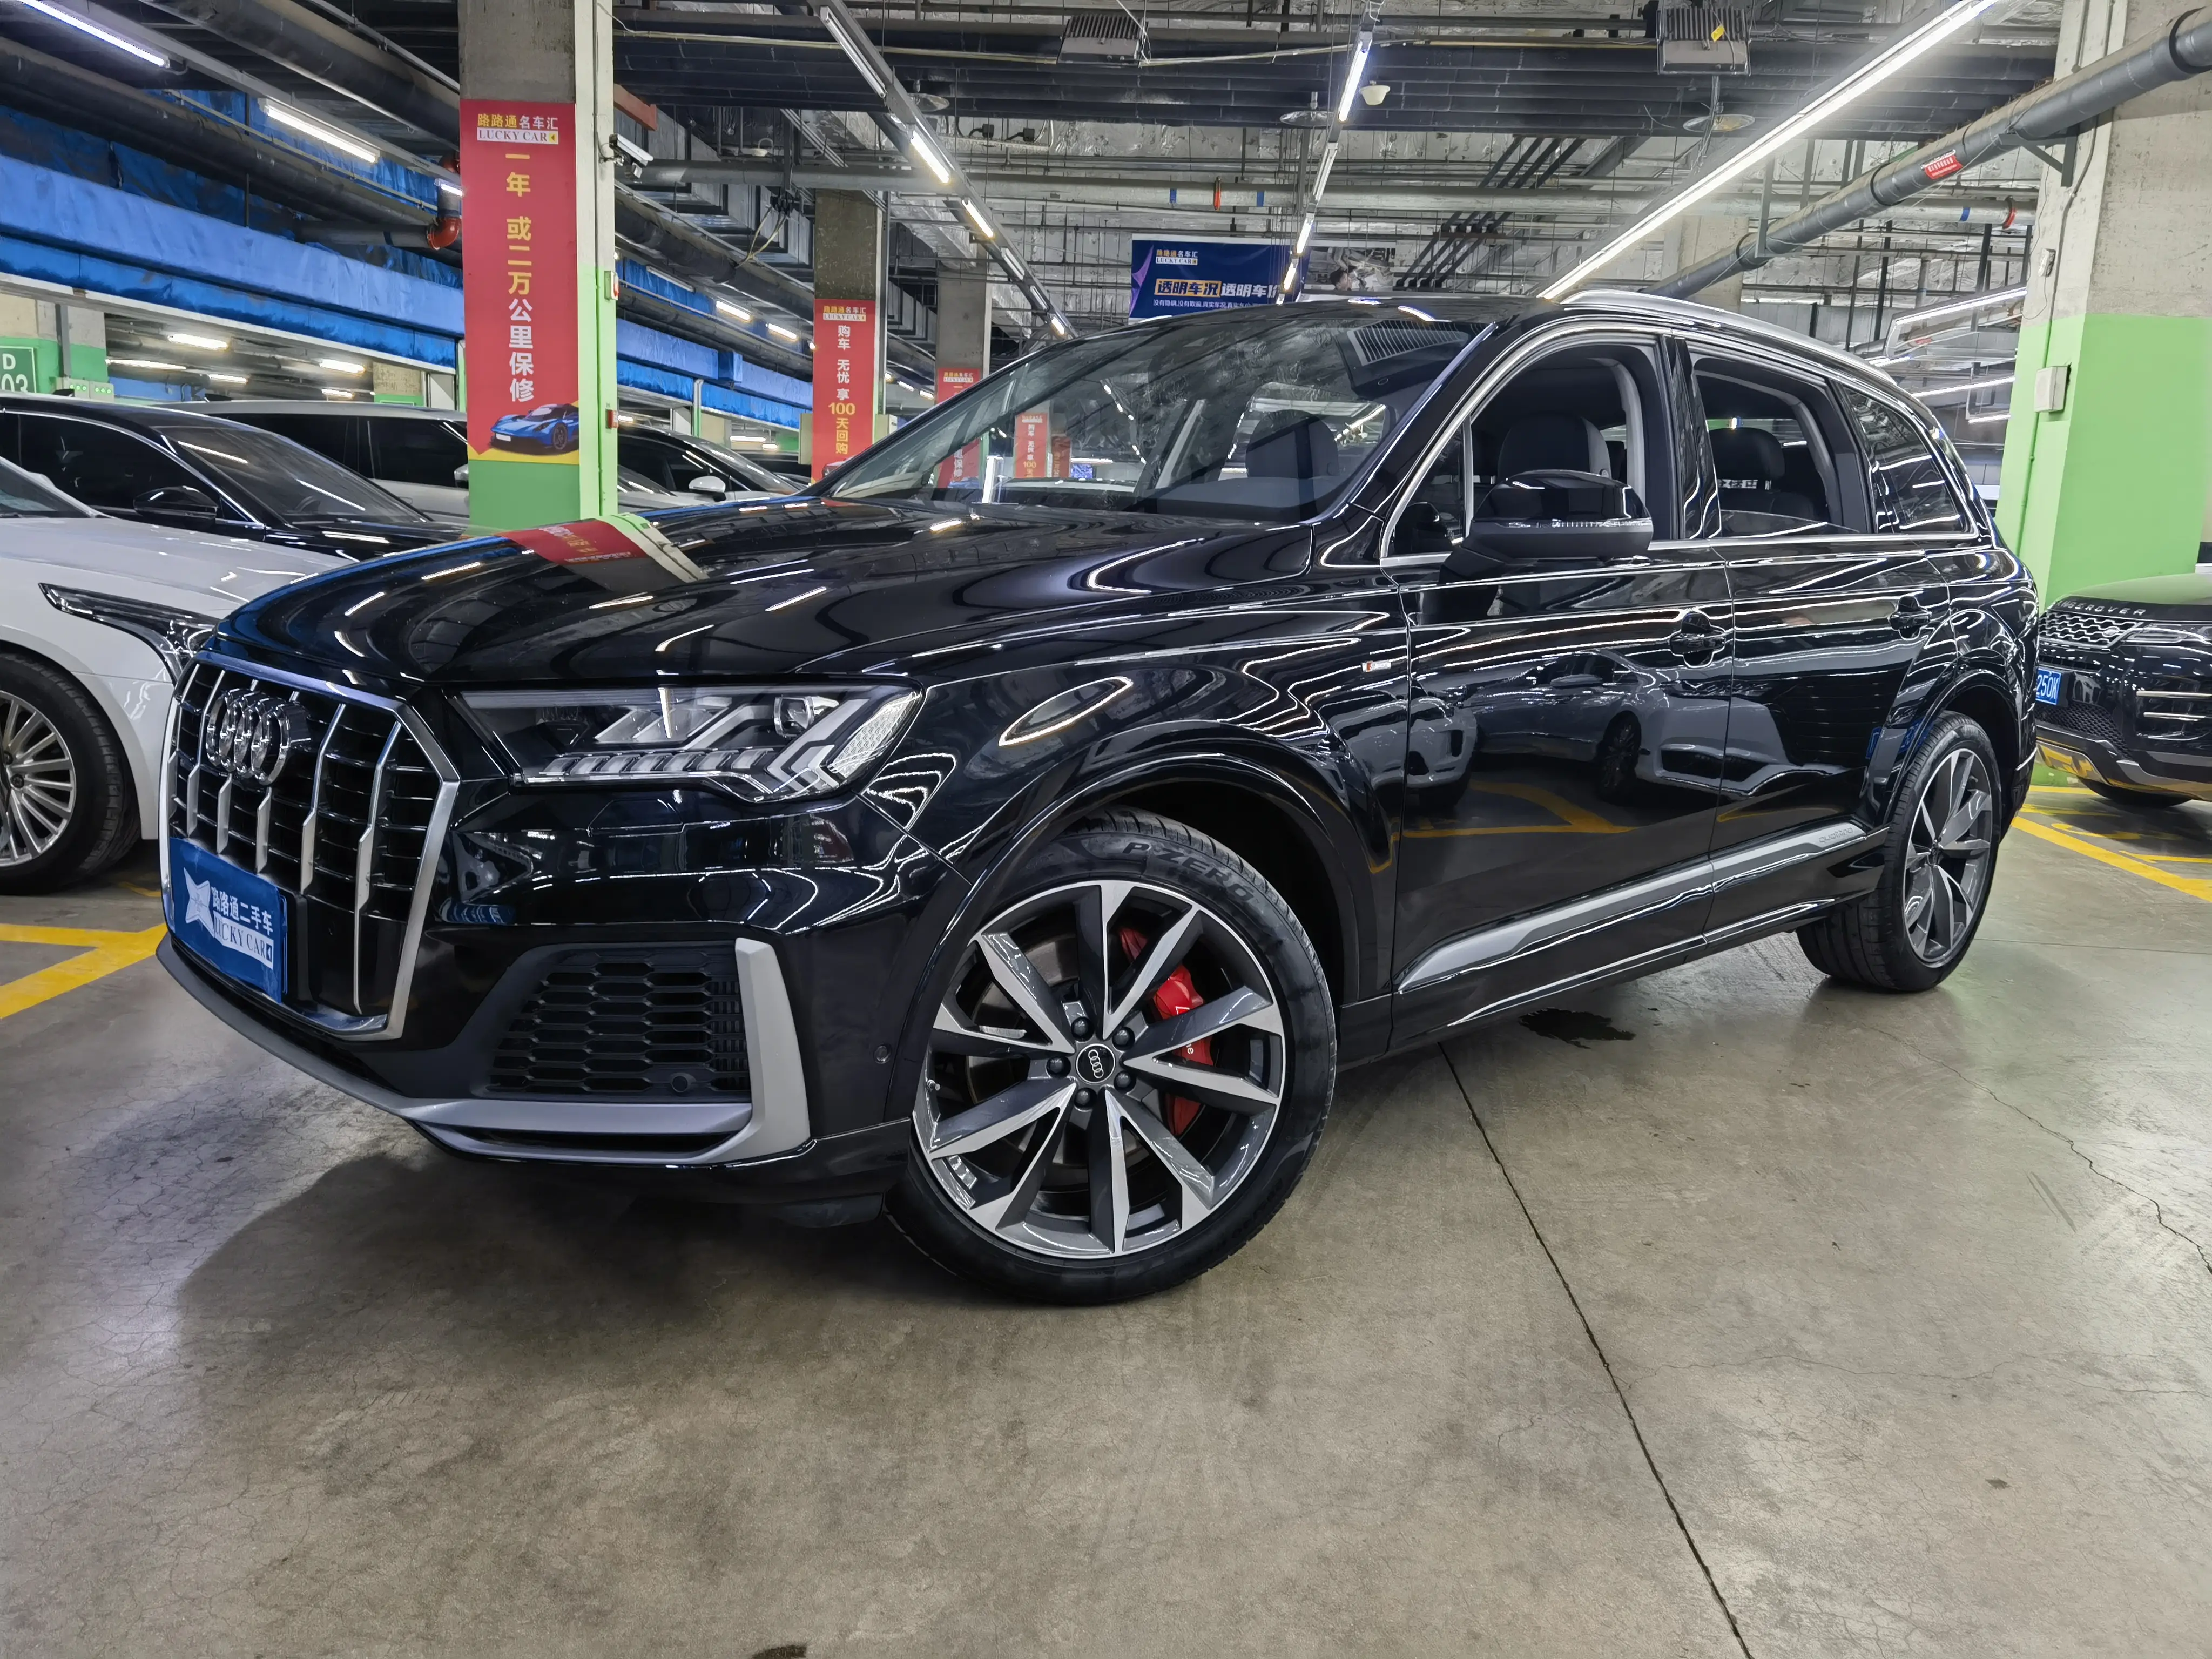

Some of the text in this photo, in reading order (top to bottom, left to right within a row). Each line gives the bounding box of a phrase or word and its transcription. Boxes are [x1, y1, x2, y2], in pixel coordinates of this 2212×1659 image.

[477, 113, 558, 130] 路路通名车汇
[478, 129, 548, 142] LUCKY CAR
[1157, 280, 1218, 296] 透明车况
[2, 353, 16, 370] D
[2085, 604, 2146, 616] ROVER
[1156, 847, 1255, 902] ZERO
[211, 886, 274, 936] 路路通二手车
[246, 933, 266, 959] CAR
